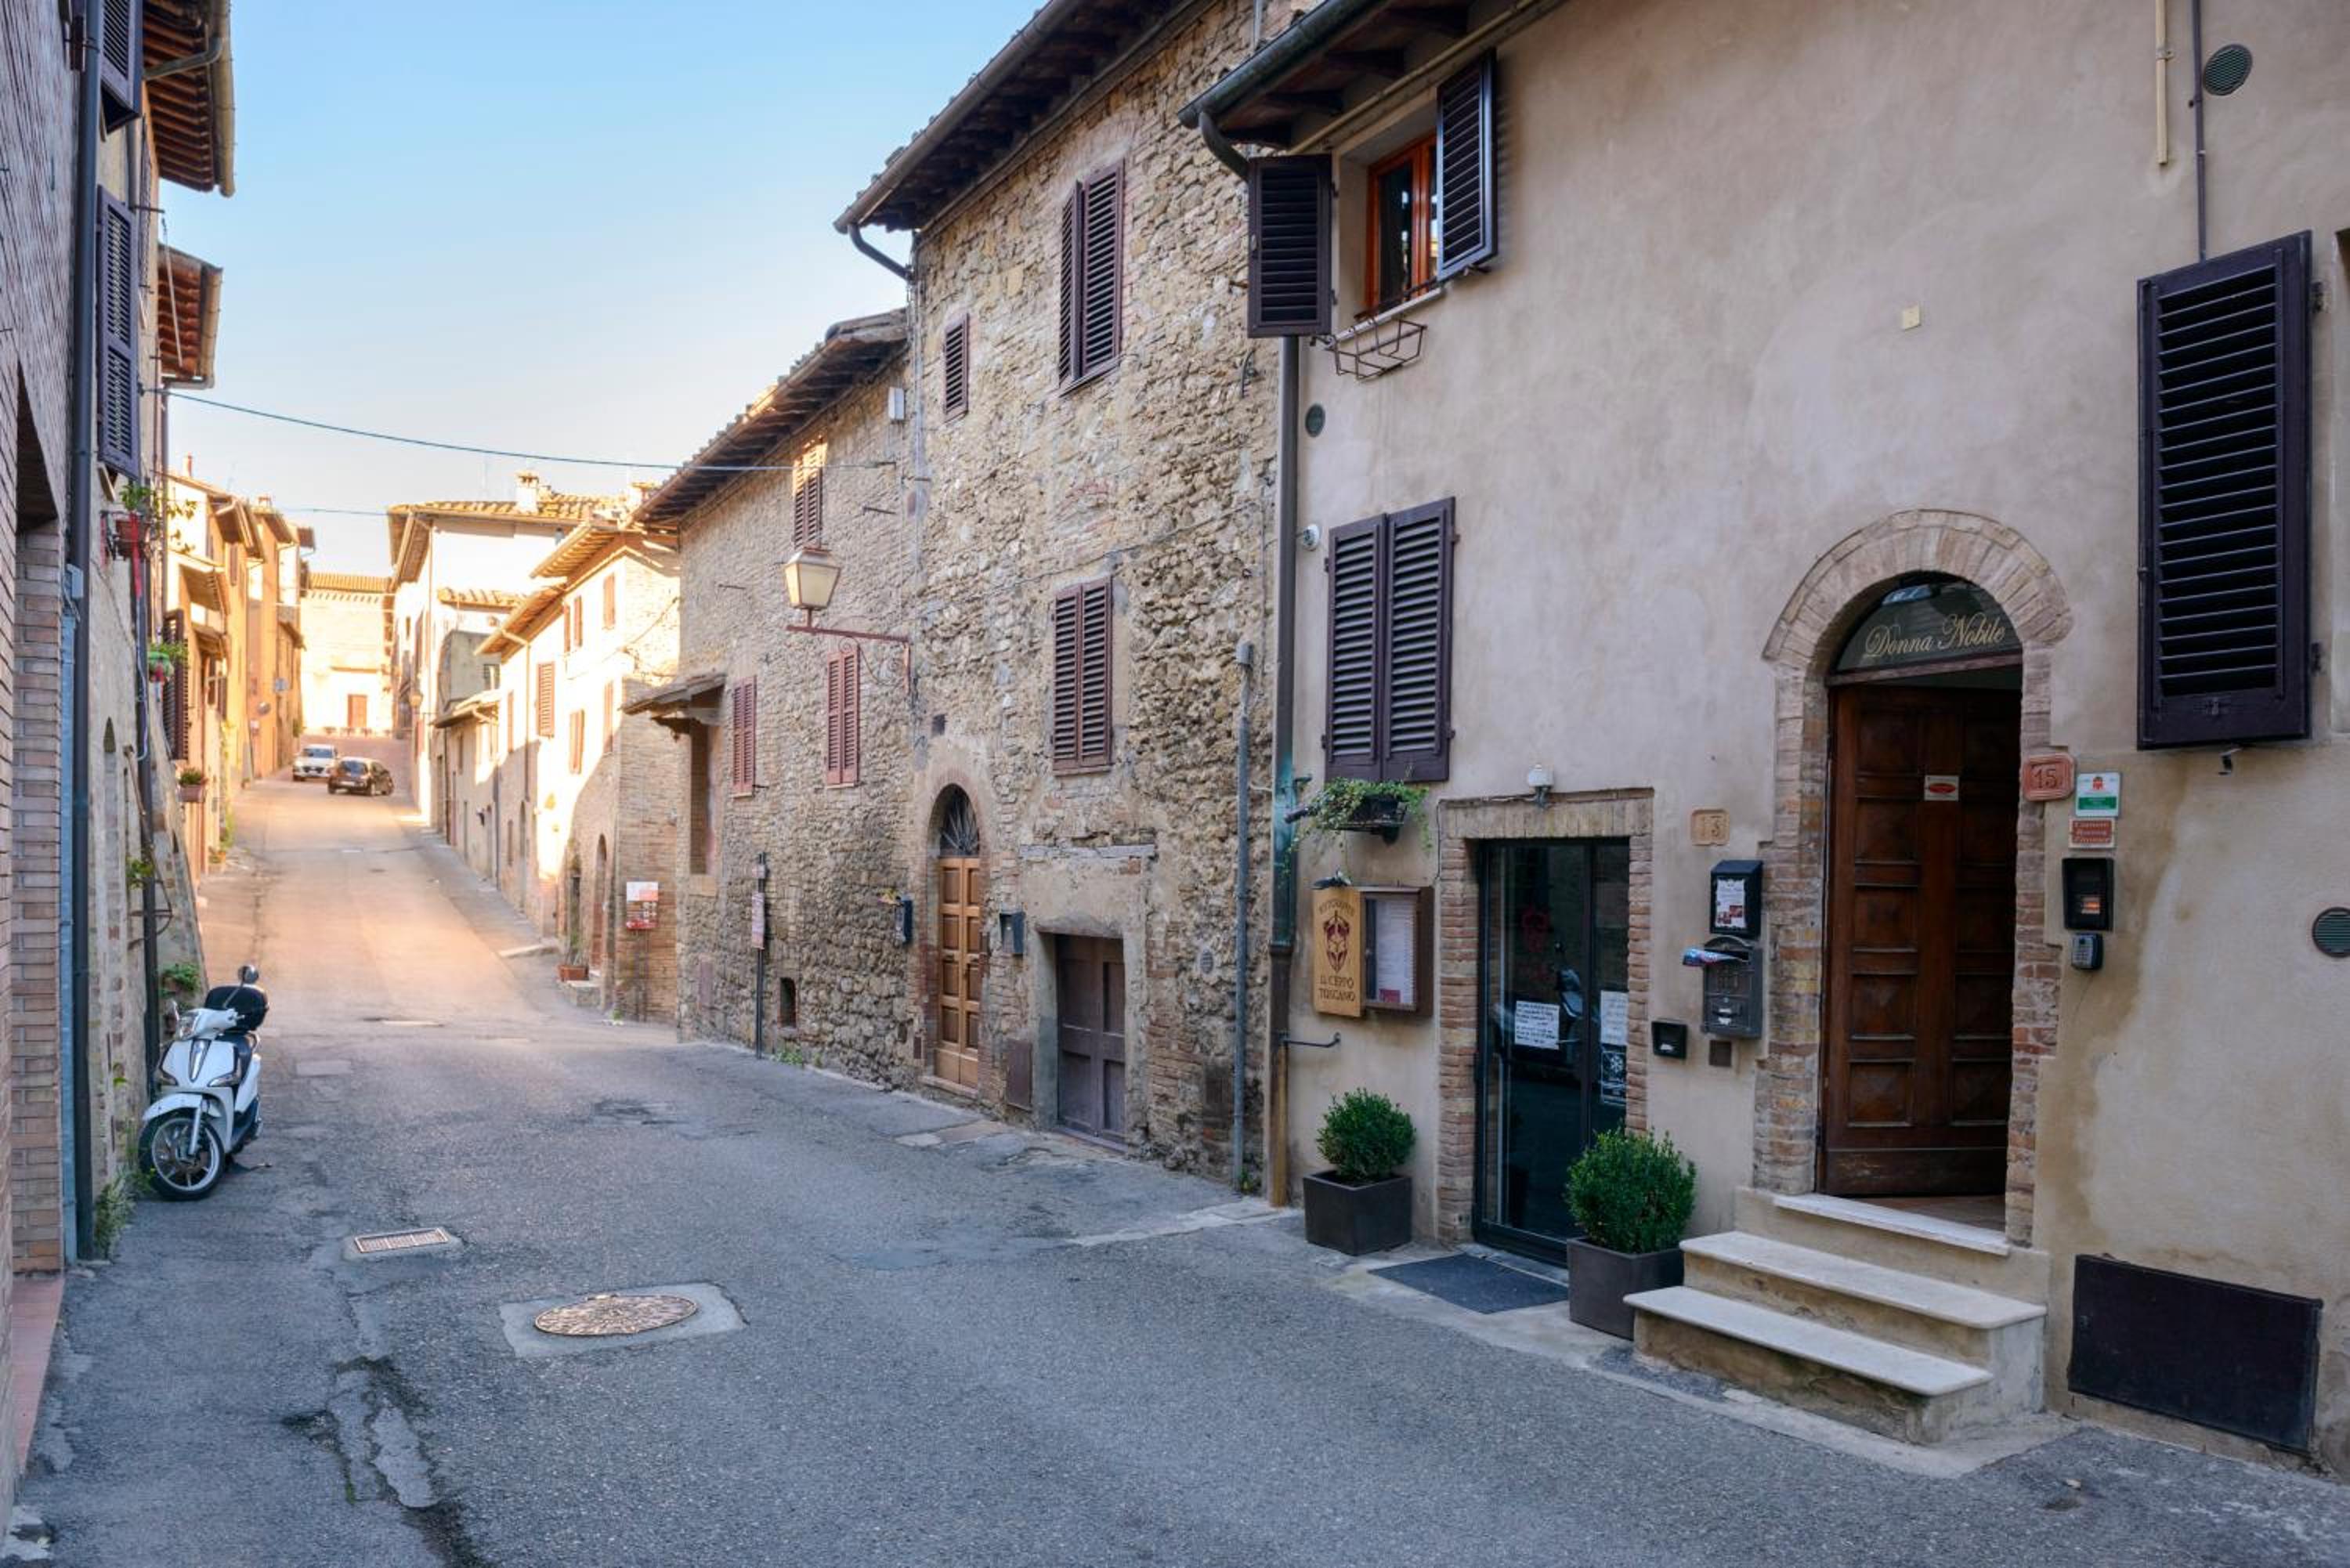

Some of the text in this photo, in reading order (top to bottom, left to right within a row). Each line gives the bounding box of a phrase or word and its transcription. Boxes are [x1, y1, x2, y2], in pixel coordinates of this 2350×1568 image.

[1865, 612, 2005, 656] Donna Nobile
[2034, 768, 2058, 789] 15
[1701, 815, 1723, 837] 13
